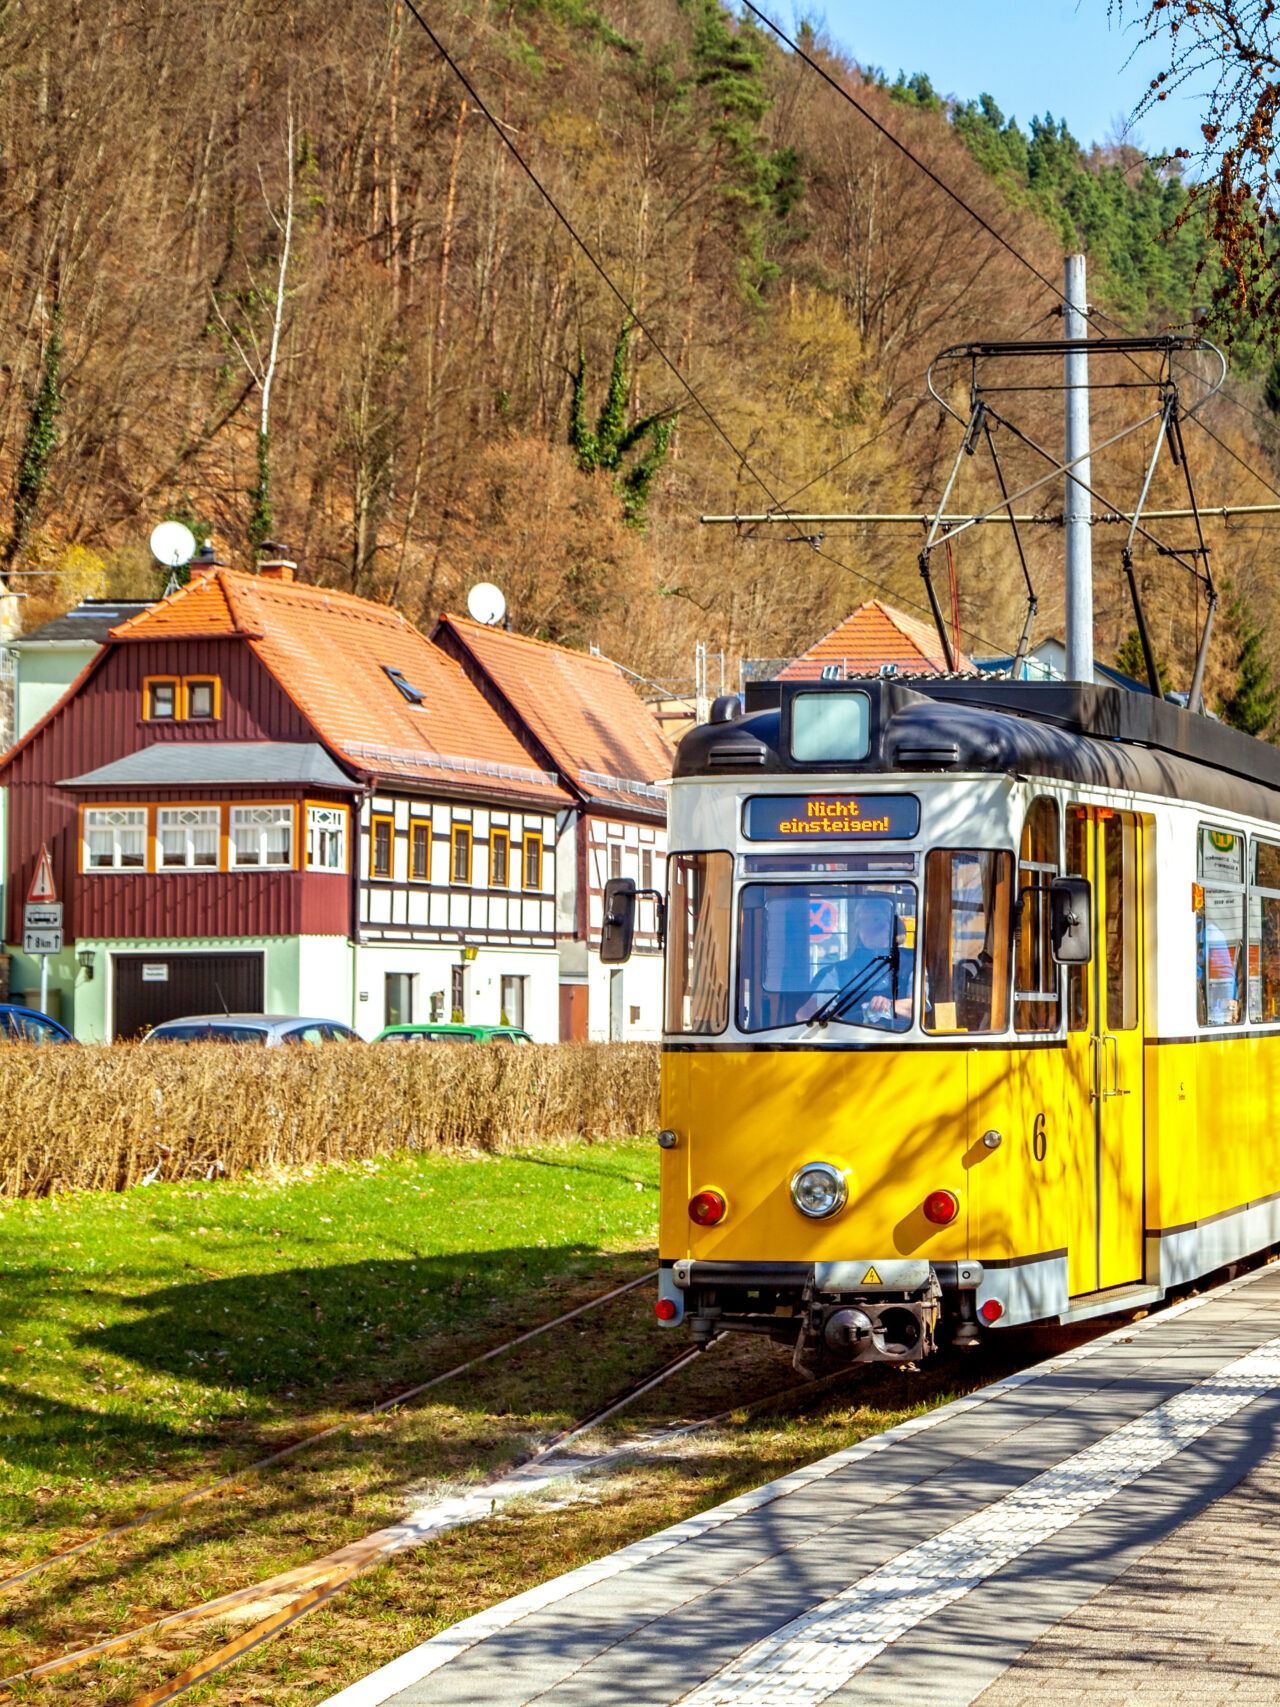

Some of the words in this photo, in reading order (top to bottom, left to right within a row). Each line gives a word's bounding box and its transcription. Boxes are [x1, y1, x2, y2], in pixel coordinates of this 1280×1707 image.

[807, 801, 859, 817] Nicht
[780, 817, 890, 833] einsteigen!
[41, 938, 52, 948] km
[1032, 1113, 1047, 1162] 6
